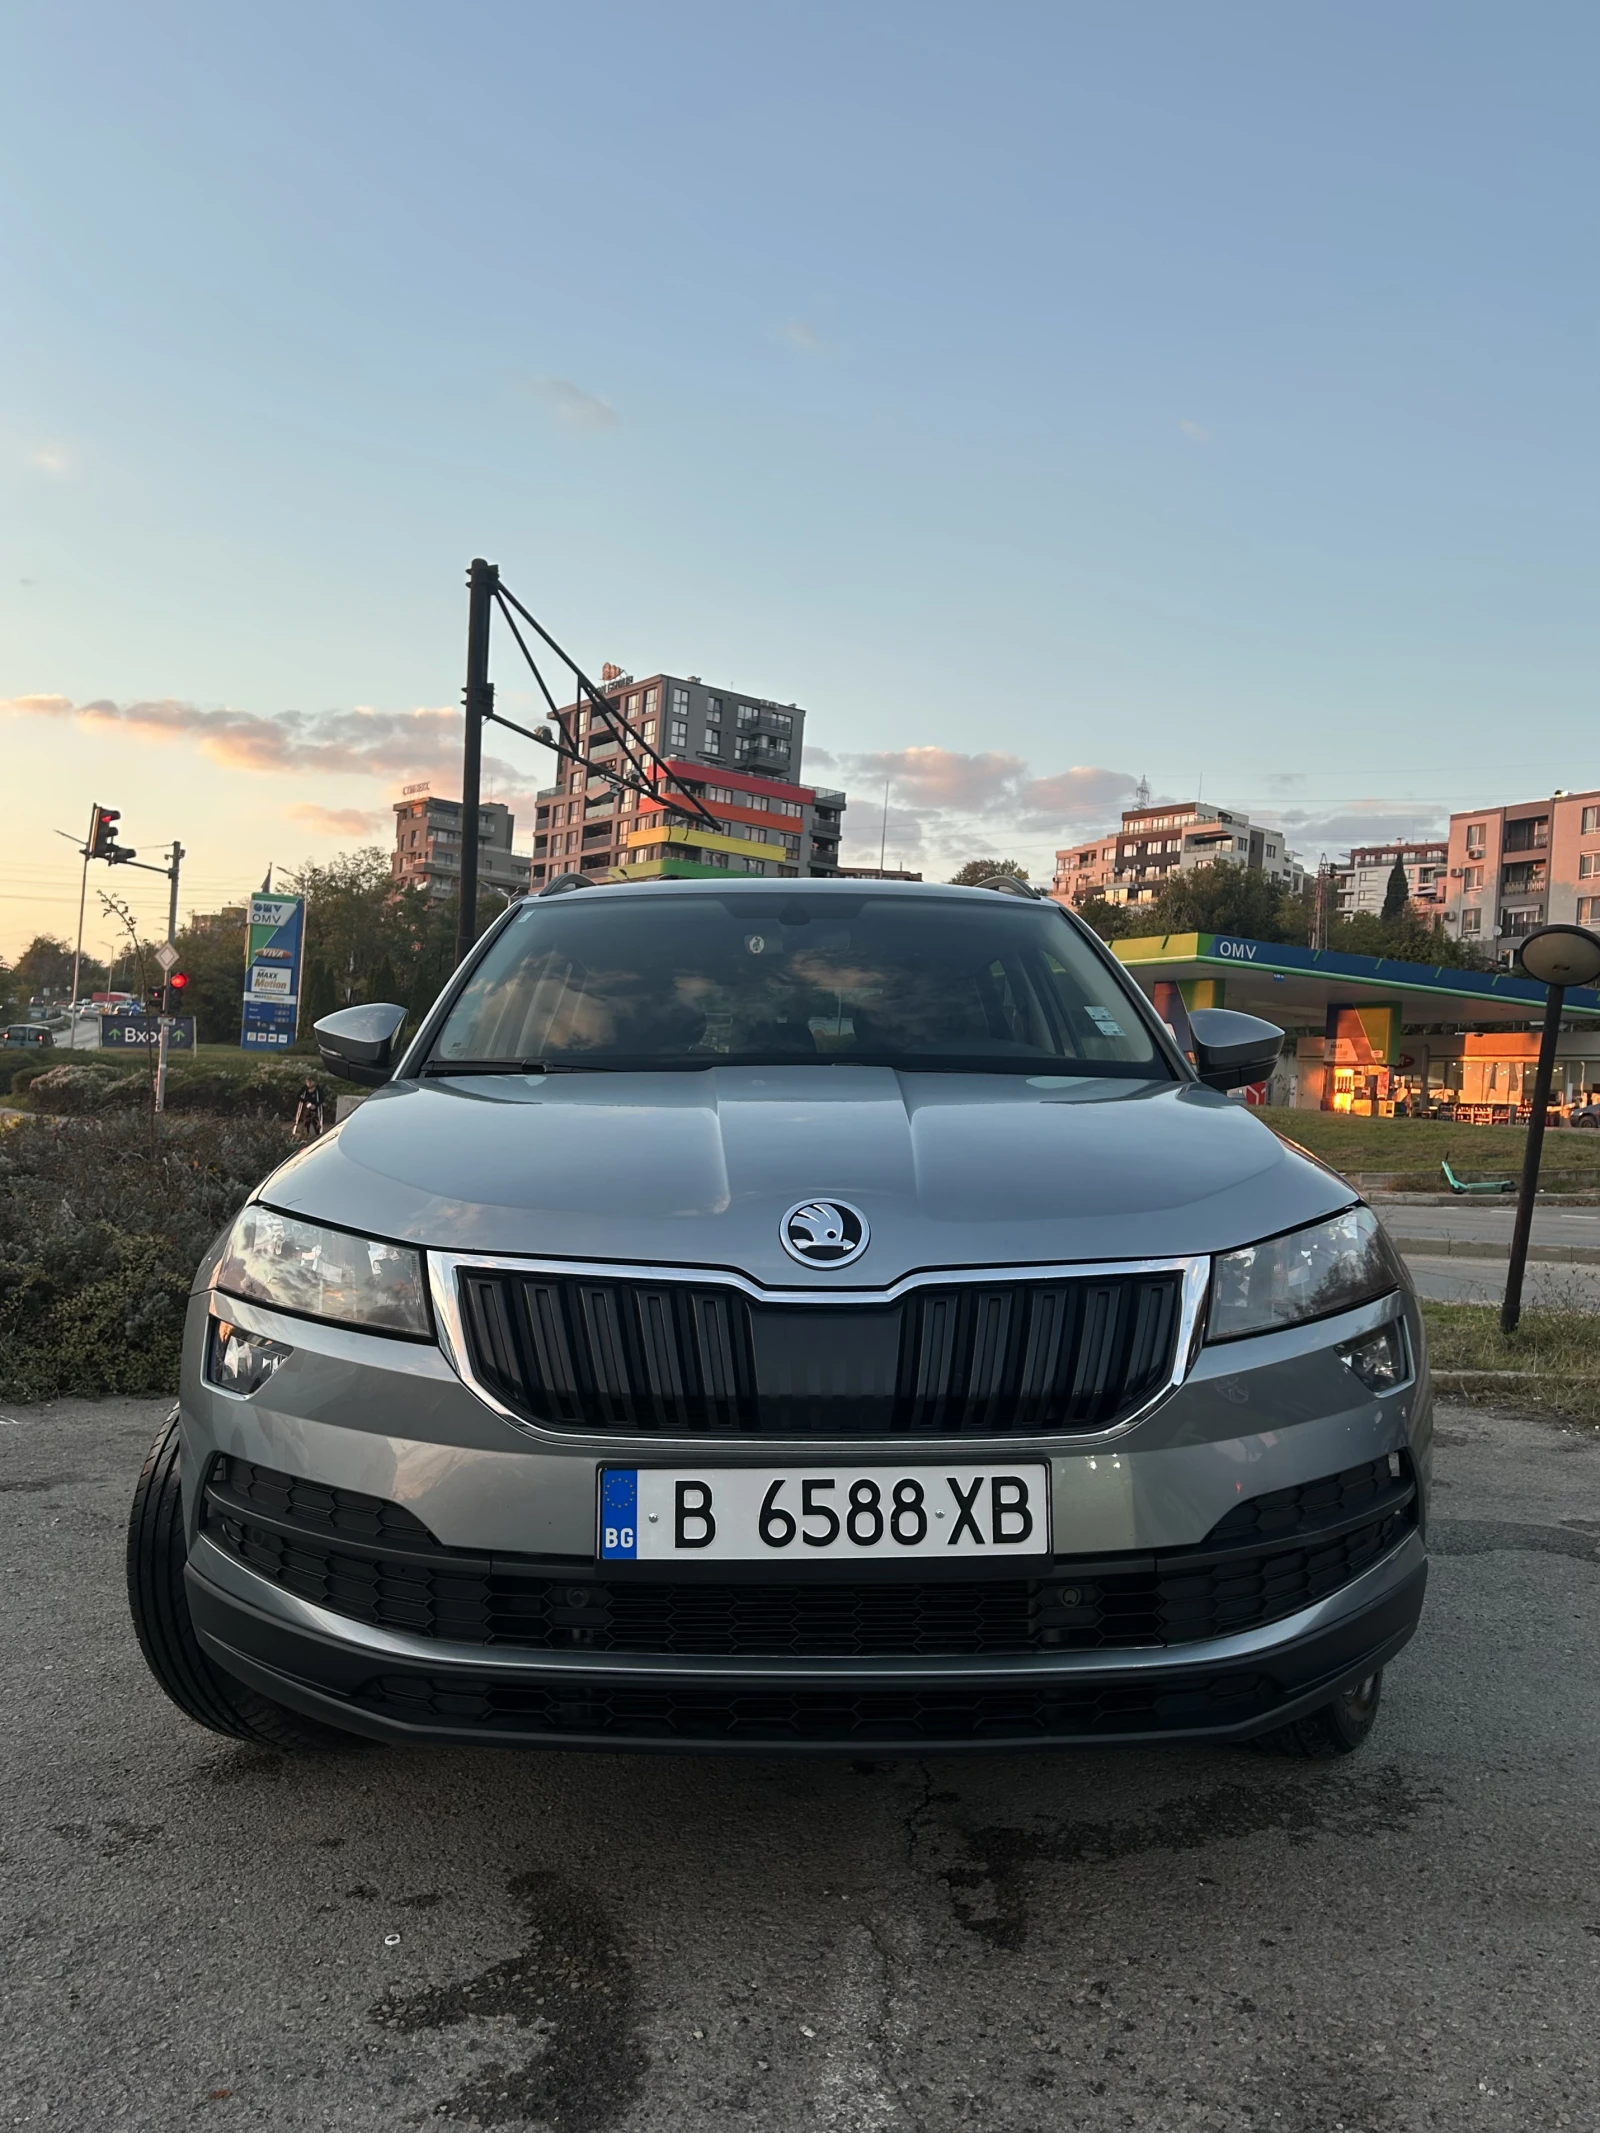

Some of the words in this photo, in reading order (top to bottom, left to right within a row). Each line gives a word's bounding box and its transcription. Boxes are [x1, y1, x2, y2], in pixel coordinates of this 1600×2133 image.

[252, 914, 281, 924] OMV
[262, 949, 284, 958] VIVA
[1220, 941, 1257, 960] OMV
[257, 971, 278, 979] MAXX
[254, 978, 287, 989] Motion
[124, 1027, 163, 1046] Вхо
[674, 1480, 717, 1549] B
[758, 1478, 928, 1548] 6588
[946, 1476, 1034, 1545] XB
[604, 1528, 634, 1549] BG
